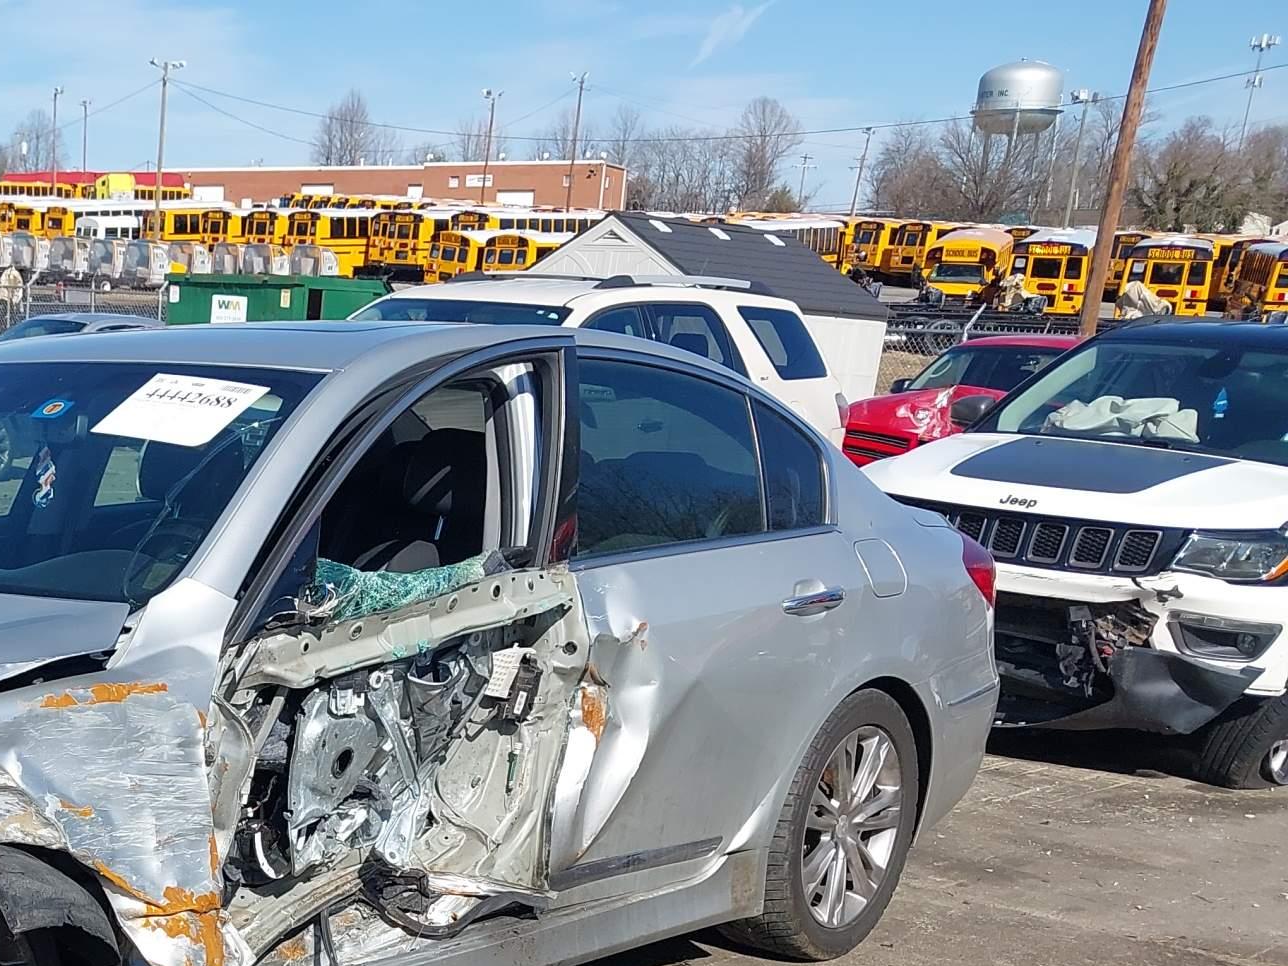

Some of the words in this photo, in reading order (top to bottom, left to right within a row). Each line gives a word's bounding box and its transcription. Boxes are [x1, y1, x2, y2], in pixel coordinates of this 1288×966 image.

[217, 299, 241, 311] WM
[145, 387, 238, 408] 44442688
[999, 494, 1038, 509] Jeep
